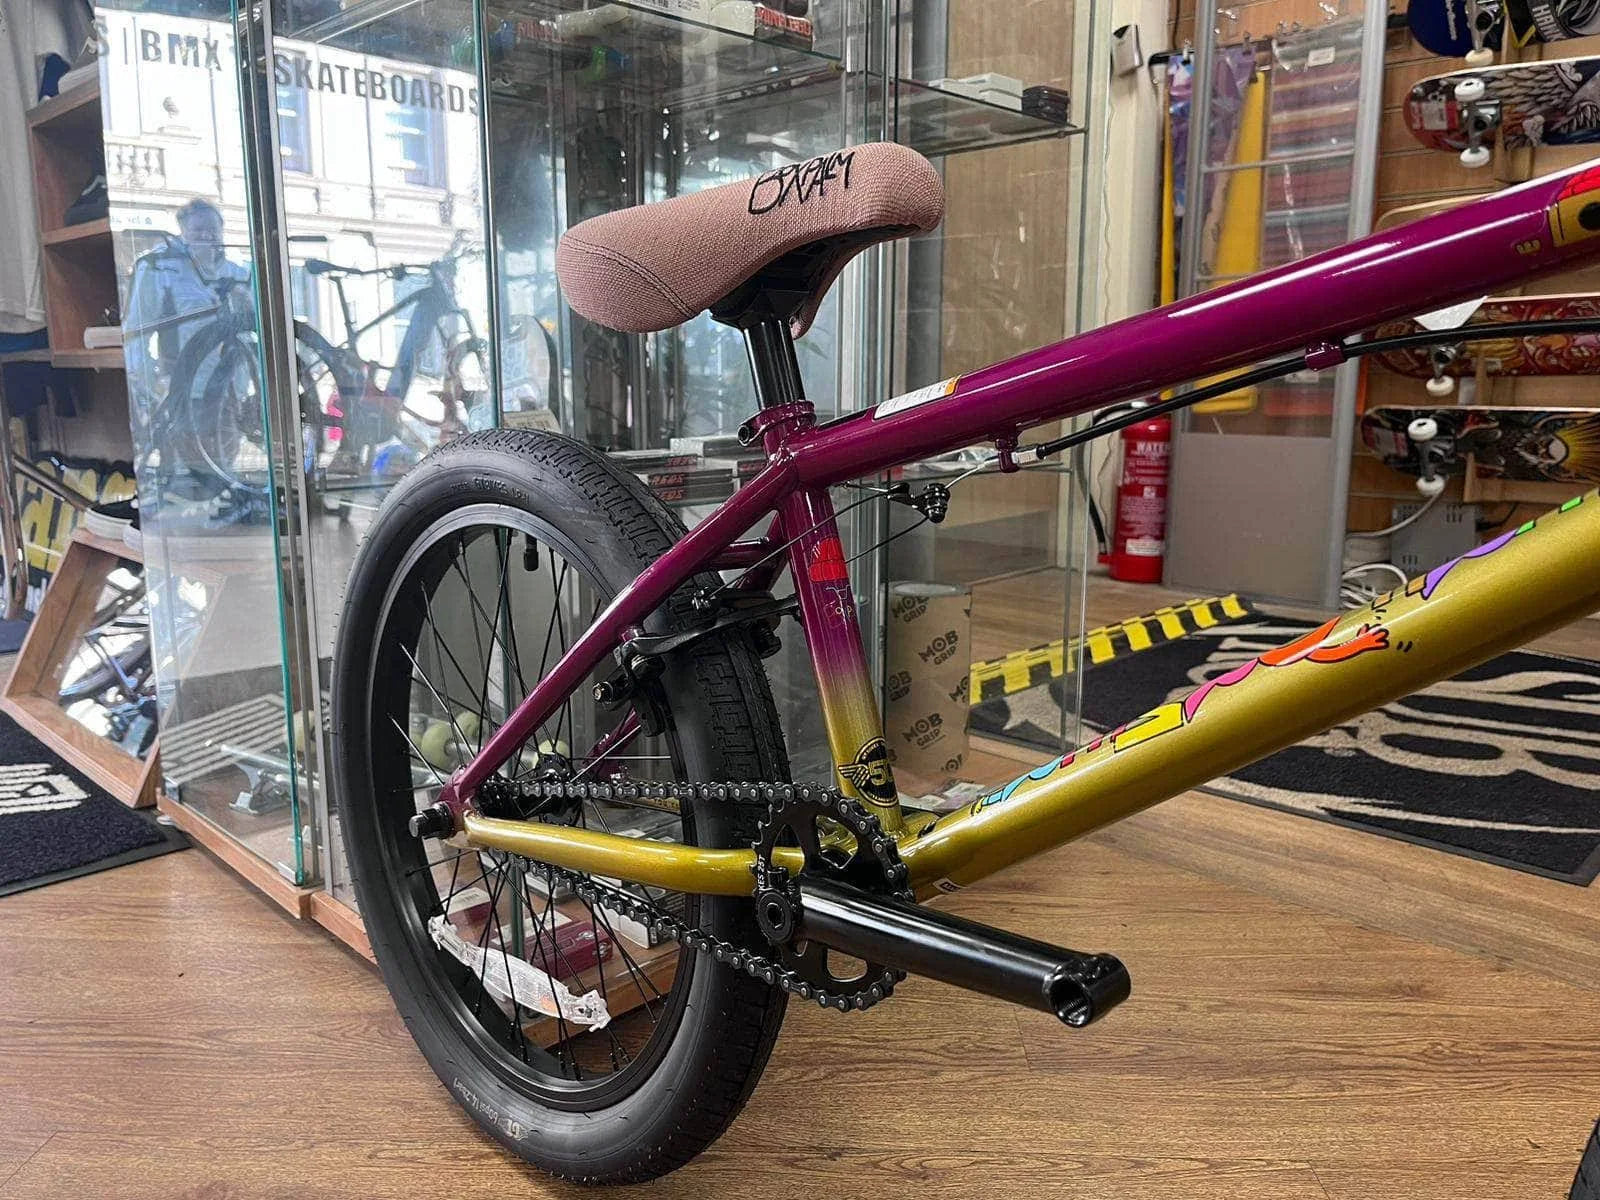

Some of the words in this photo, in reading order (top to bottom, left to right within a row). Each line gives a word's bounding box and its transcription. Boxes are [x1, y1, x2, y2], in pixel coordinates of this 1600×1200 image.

[140, 28, 222, 71] BMX
[274, 53, 479, 115] SKATEBOARDS
[918, 630, 959, 663] MOB
[933, 645, 957, 666] GRIP
[887, 669, 912, 690] OB
[902, 712, 943, 743] MOB
[916, 728, 941, 747] GRIP
